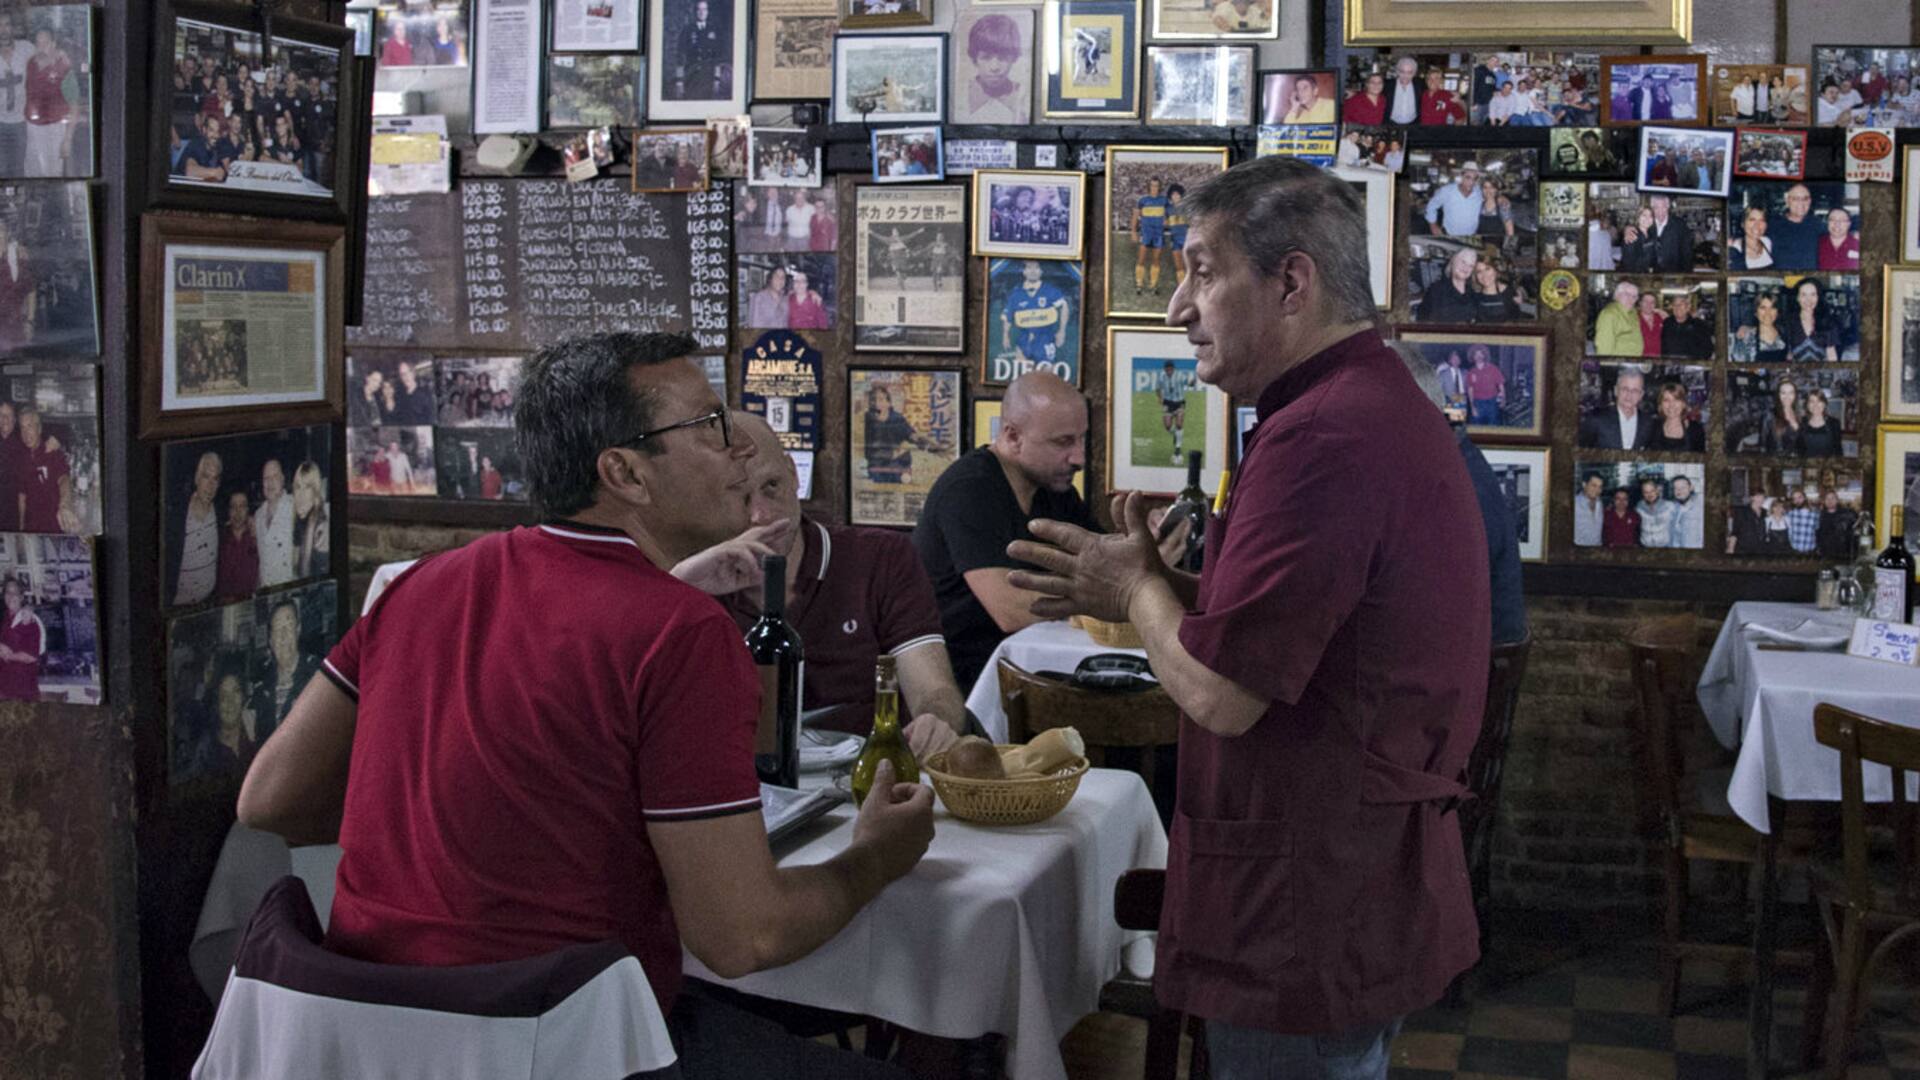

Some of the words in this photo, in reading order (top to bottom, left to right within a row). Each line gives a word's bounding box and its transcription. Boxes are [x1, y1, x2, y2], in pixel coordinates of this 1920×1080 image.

[560, 183, 568, 195] Y
[178, 263, 234, 288] Clarín
[756, 339, 805, 359] CASA
[771, 405, 784, 424] 15
